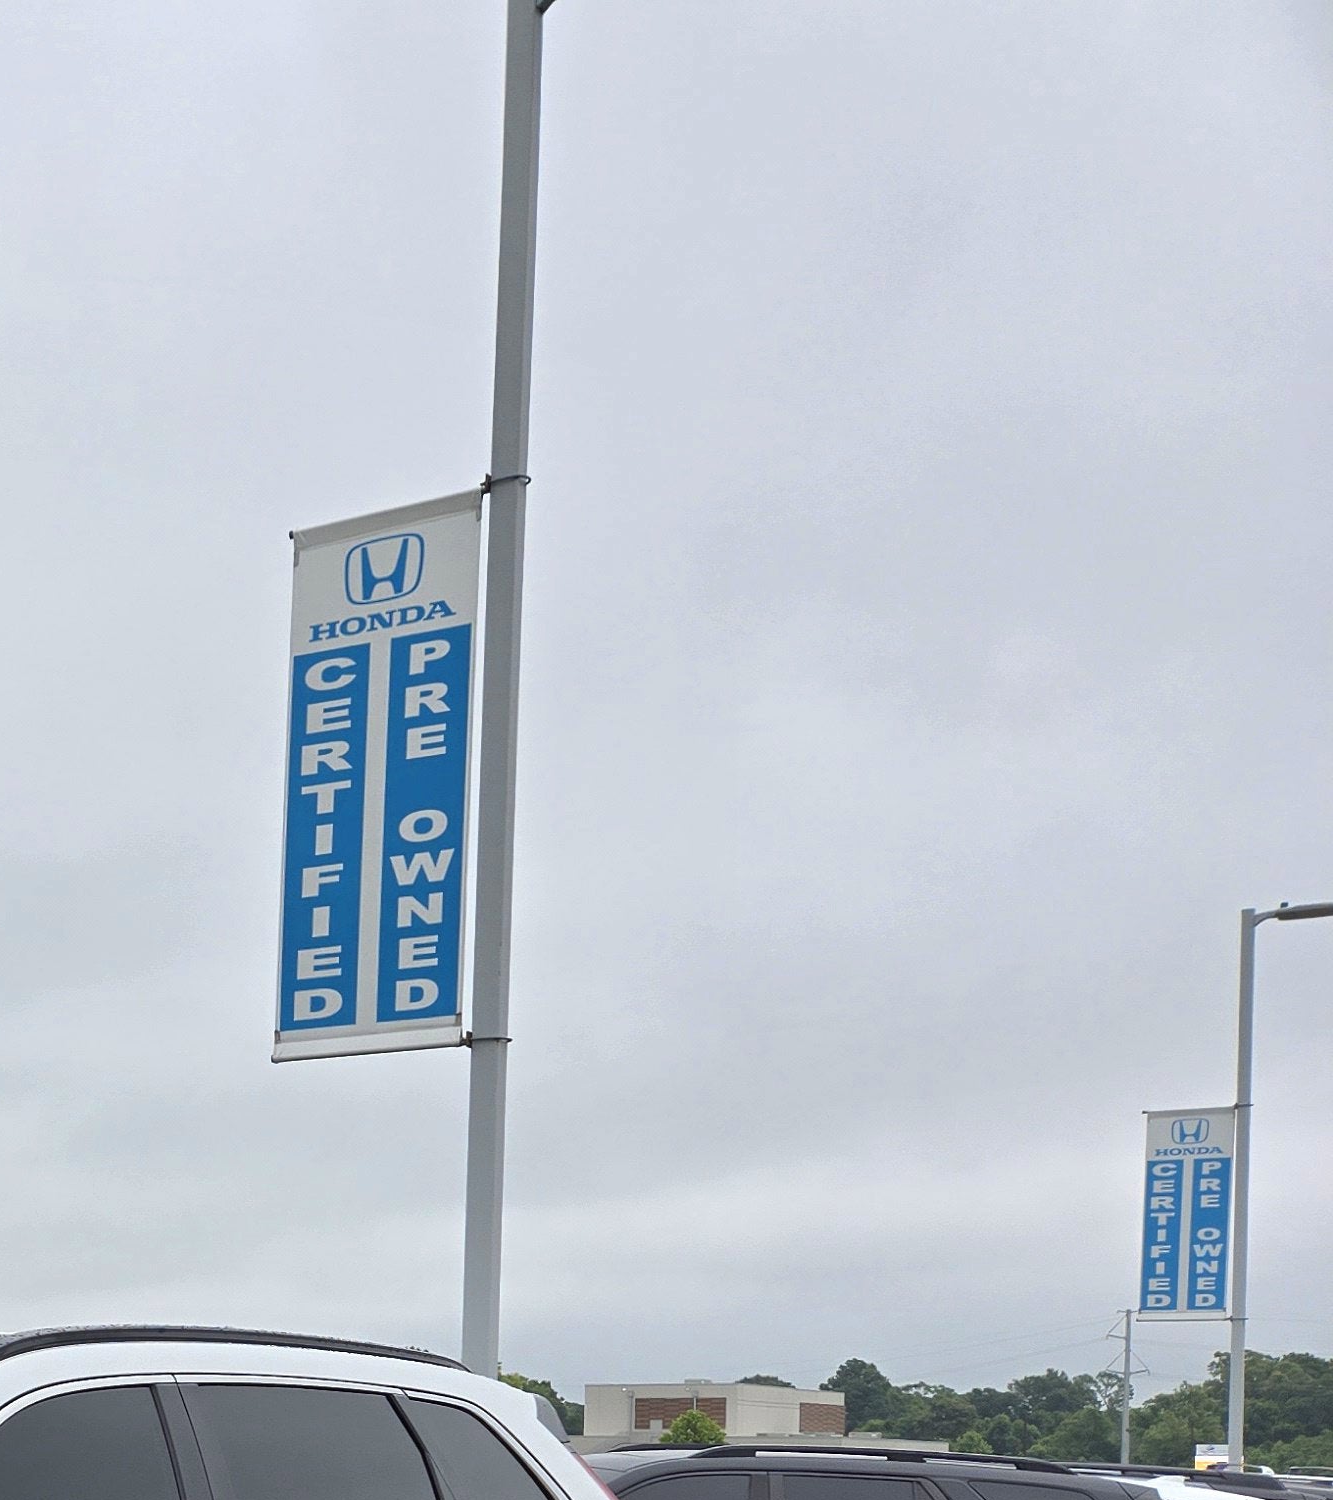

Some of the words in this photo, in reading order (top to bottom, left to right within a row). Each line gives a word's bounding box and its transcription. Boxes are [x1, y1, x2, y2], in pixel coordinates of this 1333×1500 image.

[308, 599, 457, 643] HONDA
[404, 638, 452, 761] PRE
[292, 656, 358, 1022] CERTIFIED
[389, 808, 455, 1013] OWNED
[1154, 1145, 1223, 1157] HONDA
[1199, 1160, 1222, 1209] PRE
[1146, 1162, 1178, 1308] CERTIFIED
[1192, 1226, 1224, 1308] OWNED
